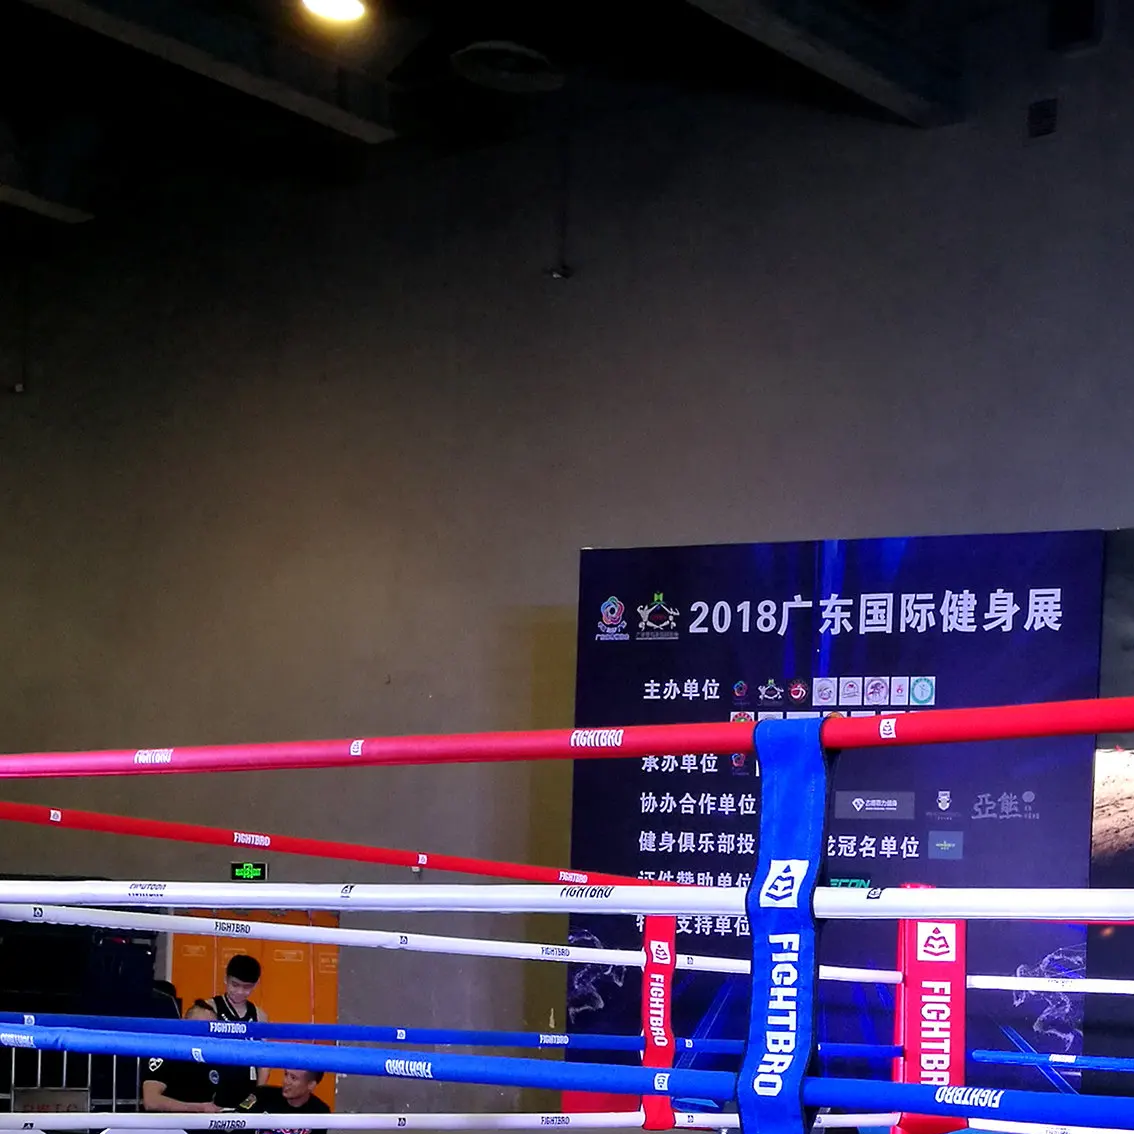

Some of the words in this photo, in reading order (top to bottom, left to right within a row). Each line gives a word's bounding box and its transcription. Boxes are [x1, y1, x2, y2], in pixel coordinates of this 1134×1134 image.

[689, 588, 1062, 637] 2018广东国际健身展
[643, 679, 720, 701] 主办单位
[570, 729, 624, 747] FIGHTBRO
[641, 753, 718, 773] 承办单位
[640, 792, 757, 815] 协办合作单位
[234, 831, 271, 847] FIGHTBRO
[638, 830, 755, 855] 健身俱乐部投
[558, 871, 588, 884] FIGHTBRO
[214, 921, 251, 935] FIGHTBRO
[637, 914, 751, 937] 支持单位
[541, 946, 571, 958] FIGHTBRO
[649, 974, 668, 1047] FIGHTBRO
[752, 933, 801, 1097] FIGHTBRO
[209, 1021, 247, 1034] FIGHTBRO
[920, 980, 951, 1087] FIGHTBR
[539, 1034, 569, 1045] FIGHTBRO
[385, 1058, 434, 1079] FIGHTBRO
[934, 1086, 1005, 1109] FIGHTBRO
[209, 1119, 247, 1130] FIGHTBRO
[540, 1116, 571, 1126] FIGHTBRO
